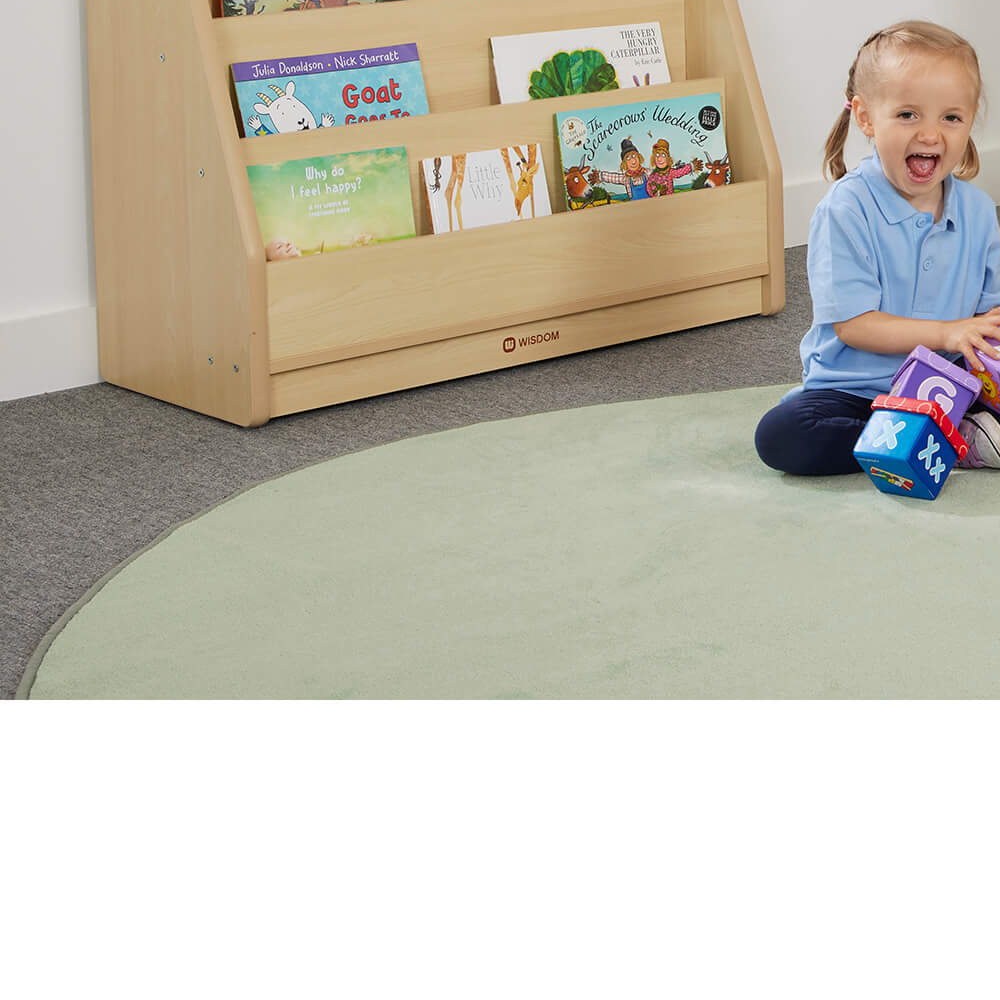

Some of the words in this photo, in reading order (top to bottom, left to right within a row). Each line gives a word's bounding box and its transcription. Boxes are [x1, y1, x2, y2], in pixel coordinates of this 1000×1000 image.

[620, 30, 635, 39] THE
[636, 28, 655, 37] VERY
[627, 37, 657, 48] HUNGRY
[251, 63, 275, 78] Julia
[278, 60, 324, 74] Donaldson
[334, 55, 357, 69] Nick
[359, 50, 399, 66] Sharratt
[610, 46, 660, 58] CATERPILLAR
[342, 78, 402, 109] Goat
[583, 107, 648, 161] Scarecrows'
[586, 115, 602, 135] The
[652, 104, 708, 147] Wedding
[305, 166, 327, 180] Why
[331, 166, 344, 177] do
[468, 163, 501, 183] Little
[290, 184, 295, 200] I
[300, 183, 320, 198] feel
[325, 176, 361, 195] happy?
[470, 180, 504, 205] Why
[518, 330, 560, 347] WISDOM
[917, 376, 957, 416] G
[872, 419, 907, 450] X
